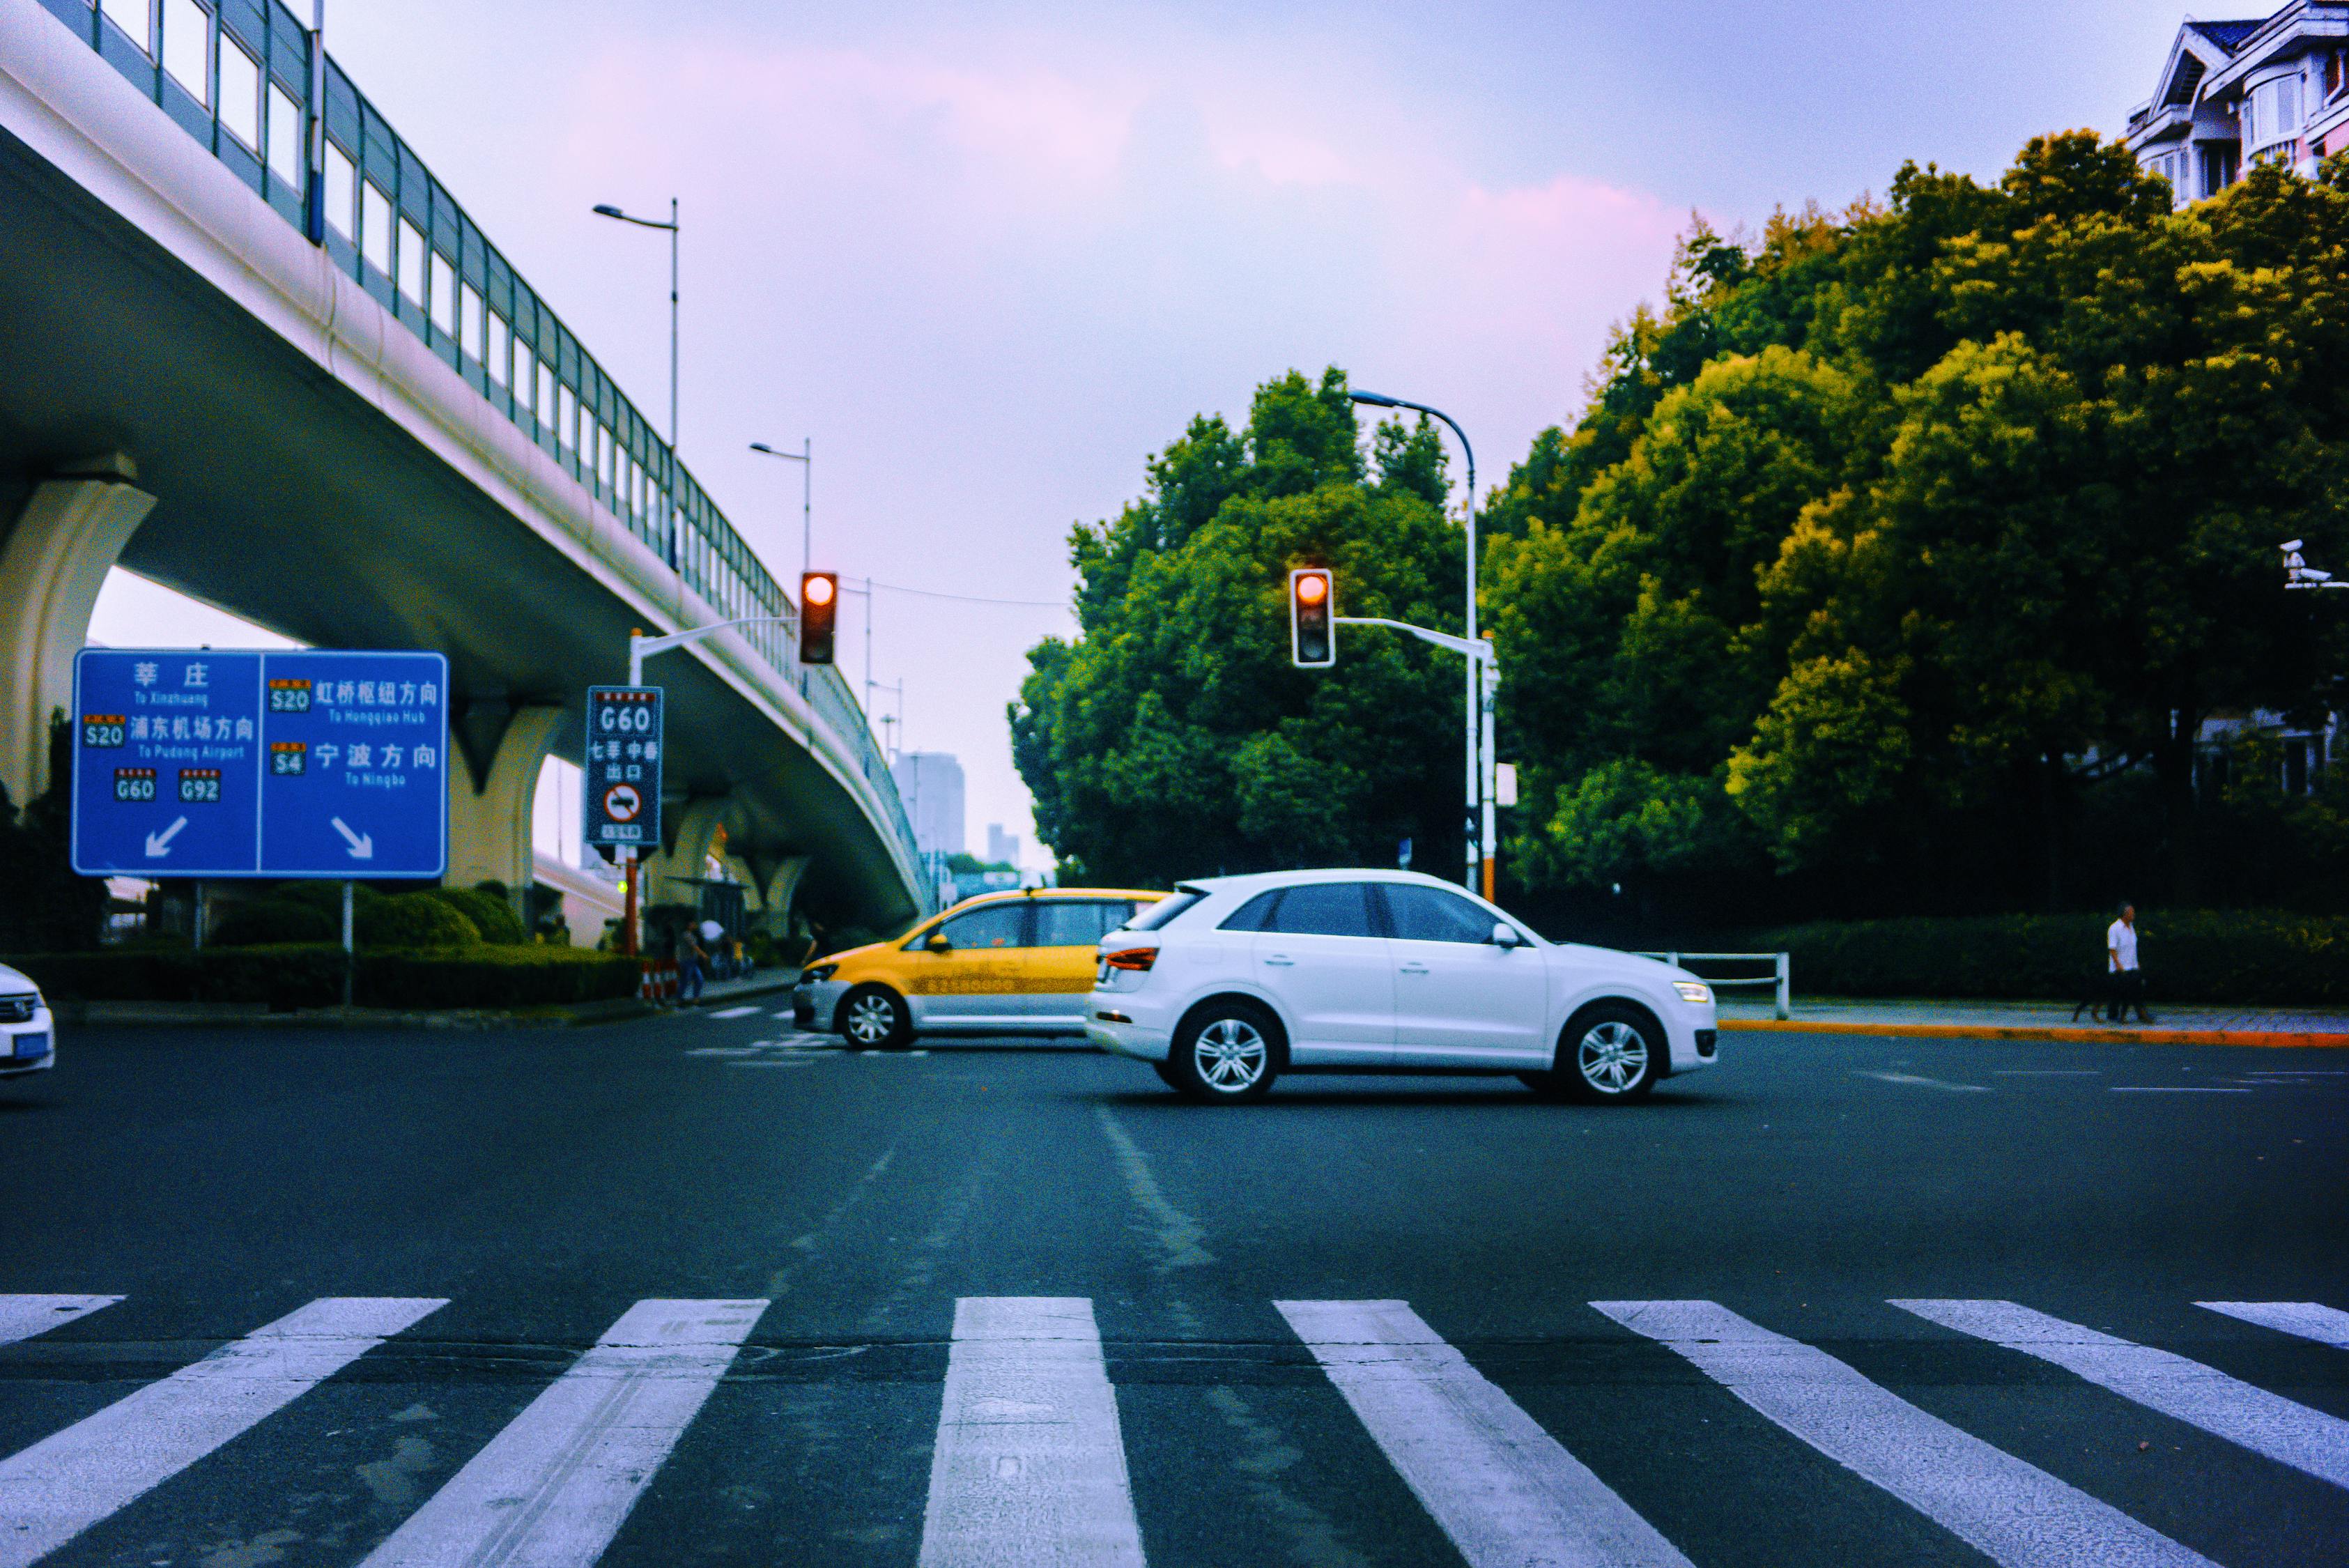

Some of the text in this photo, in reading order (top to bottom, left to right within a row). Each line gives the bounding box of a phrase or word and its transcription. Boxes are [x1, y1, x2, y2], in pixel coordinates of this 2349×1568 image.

[134, 691, 146, 705] To
[271, 691, 309, 709] S20
[316, 680, 437, 705] 虹桥枢纽方向
[329, 709, 425, 725] To Hongqiao Hub
[601, 707, 649, 730] G60
[86, 725, 123, 744] S20
[130, 716, 253, 741] 浦东机场方向
[139, 744, 244, 762] To Pudong Airport
[316, 743, 436, 769] 宁波方向
[276, 754, 302, 772] S4
[346, 771, 406, 788] To Ningbo
[116, 780, 155, 799] G60
[180, 781, 220, 800] G92
